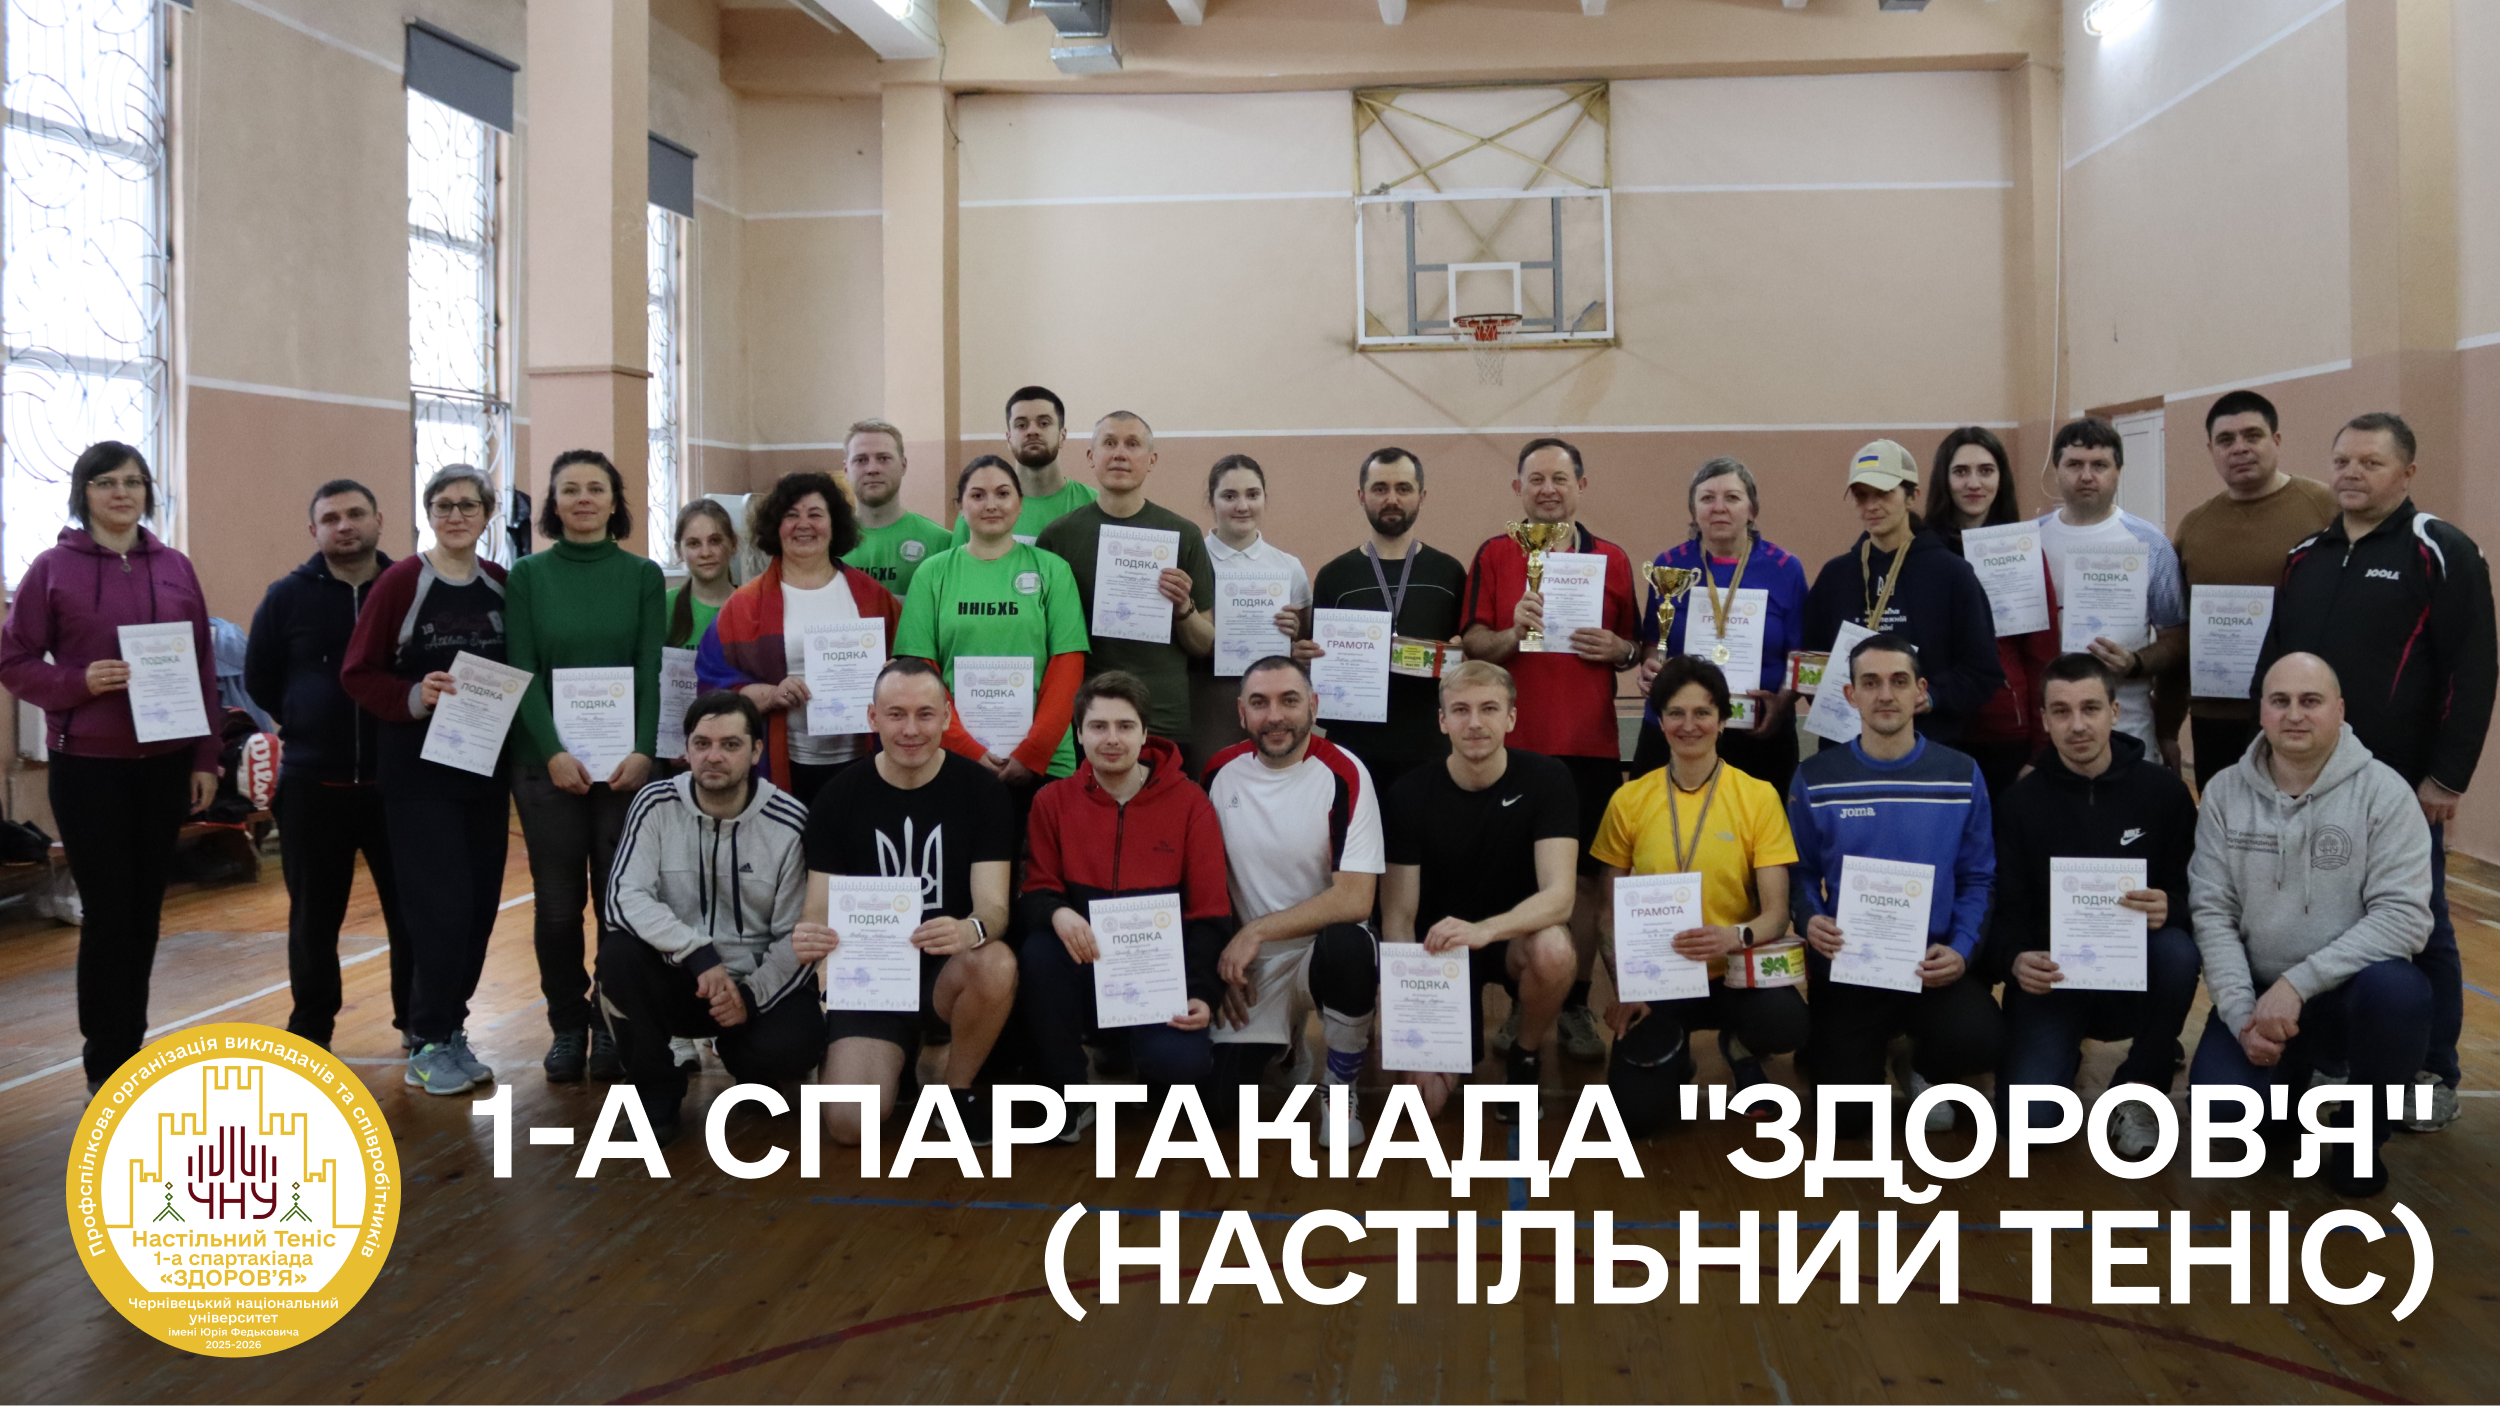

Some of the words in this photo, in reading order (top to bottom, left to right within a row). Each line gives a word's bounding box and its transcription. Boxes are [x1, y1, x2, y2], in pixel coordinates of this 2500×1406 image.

[1115, 558, 1159, 570] ПОДЯКА
[1983, 554, 2026, 567] ПОДЯКА
[855, 566, 897, 581] ІБХБ
[2083, 572, 2129, 582] ПОДЯКА
[2365, 568, 2400, 580] JOOLA
[1542, 577, 1590, 585] ГРАМОТА
[957, 601, 1019, 616] ННІБХБ
[1232, 598, 1275, 608] ПОДЯКА
[1702, 615, 1750, 626] ГРОТА
[2208, 616, 2253, 627] ПОДЯКА
[1327, 640, 1375, 650] ГРАМОТА
[140, 655, 181, 666] ПОДЯКА
[822, 651, 868, 661] ПОДЯКА
[671, 679, 697, 690] ПОДЯ
[461, 683, 503, 701] ПОДЯКА
[970, 689, 1015, 699] ПОДЯКА
[571, 699, 616, 709] ПОДЯКА
[250, 733, 273, 811] Wilso
[2123, 828, 2142, 839] NIKE
[1860, 893, 1910, 908] ПОДЯКА
[1631, 905, 1684, 918] ГРАМОТА
[848, 914, 900, 925] ПОДЯКА
[1112, 931, 1162, 945] ПОДЯКА
[1400, 979, 1450, 991] ПОДЯКА
